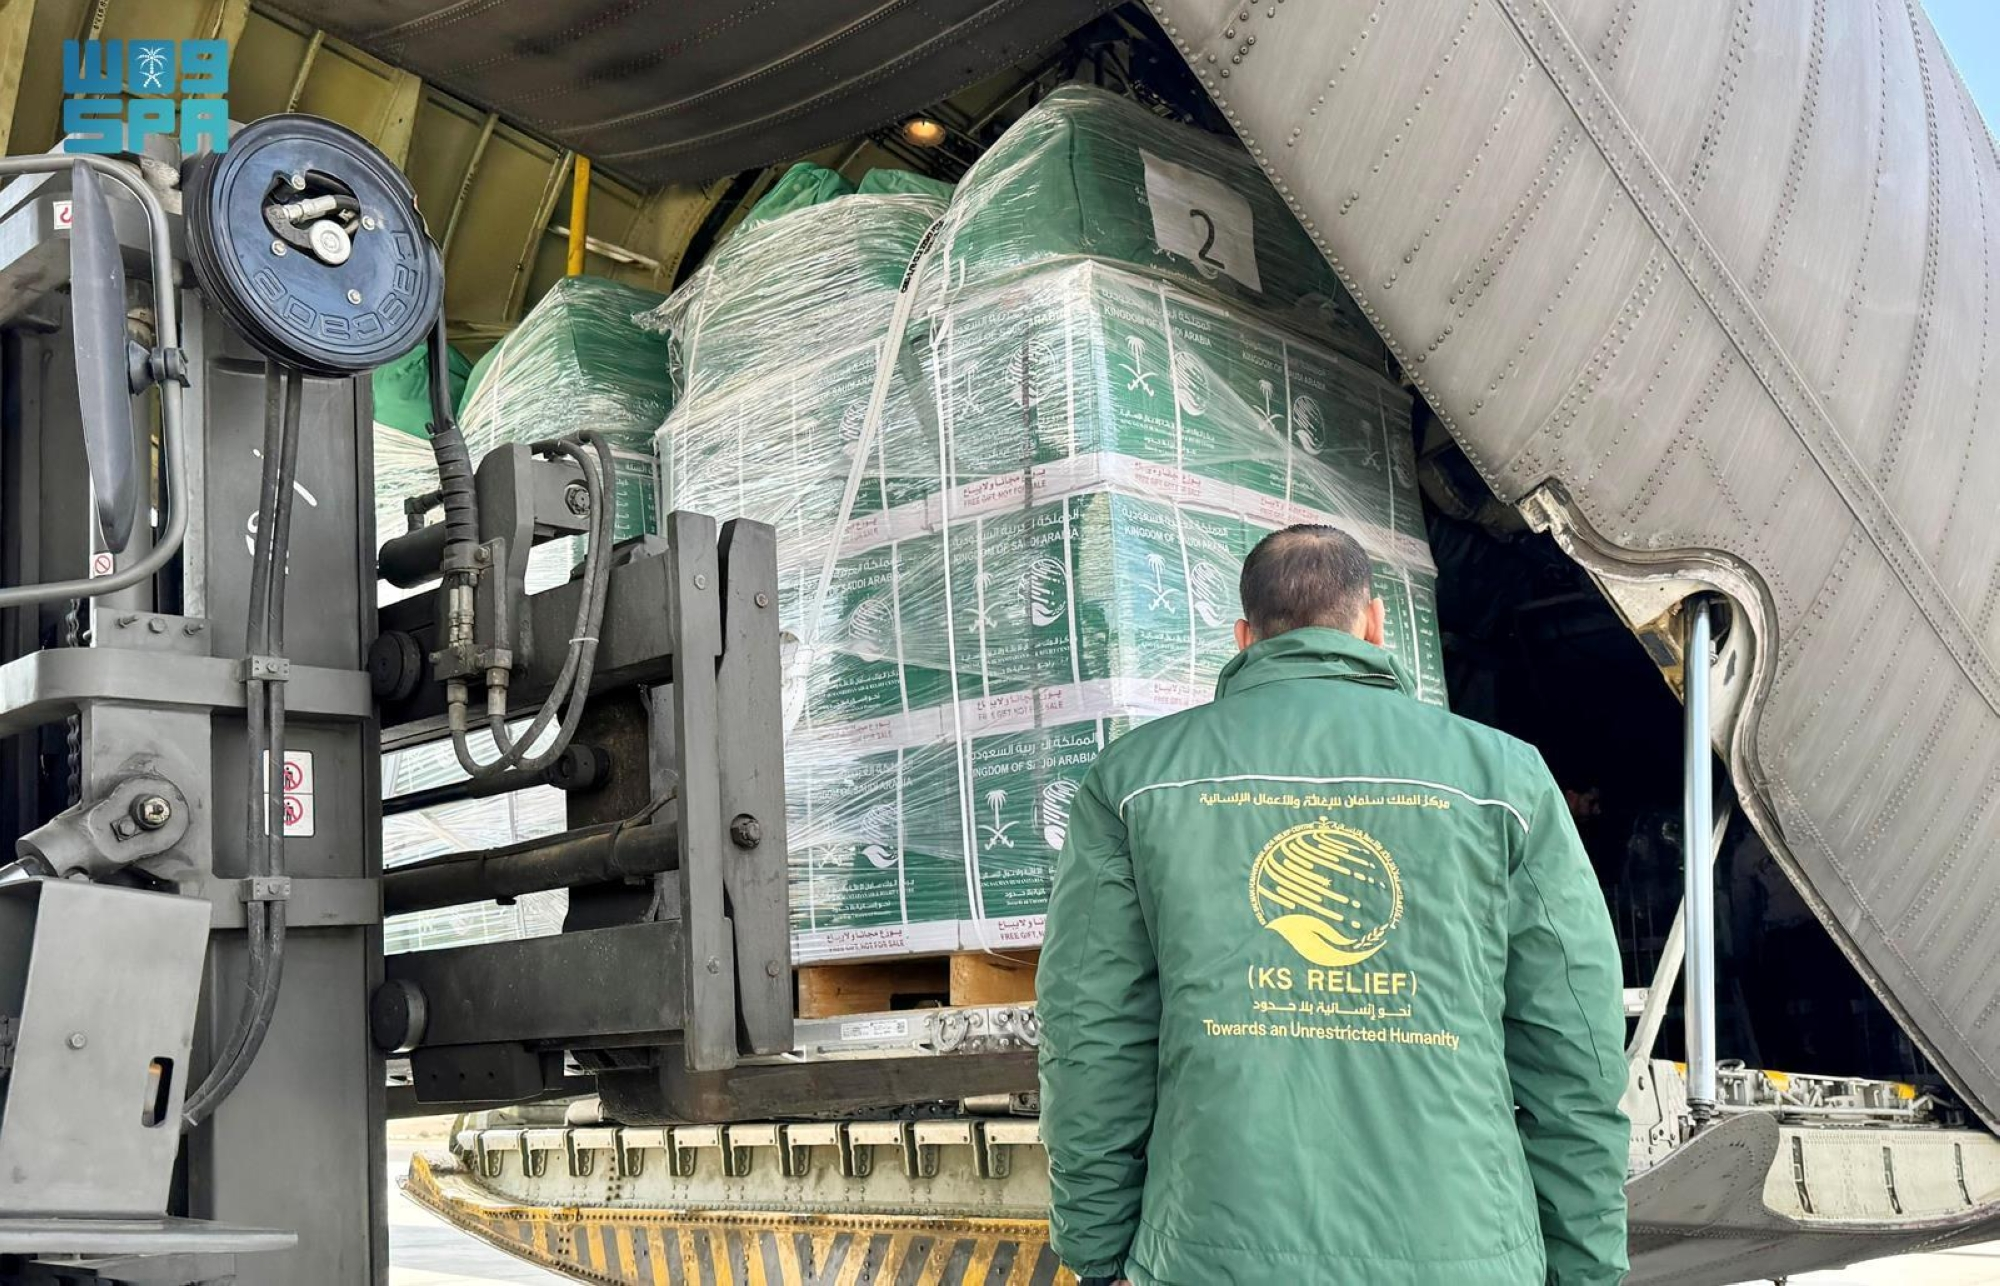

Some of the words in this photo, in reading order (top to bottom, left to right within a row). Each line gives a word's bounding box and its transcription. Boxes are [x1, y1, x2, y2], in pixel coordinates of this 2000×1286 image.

[1189, 209, 1225, 270] 2
[1123, 525, 1162, 541] KINGDOM
[1011, 761, 1023, 773] OF
[1058, 751, 1098, 767] ARABIA
[1344, 793, 1384, 809] سلمان
[1386, 793, 1421, 807] الملك
[1422, 794, 1450, 810] مركز
[1000, 932, 1020, 941] FREE
[1247, 964, 1293, 991] (KS
[1307, 968, 1419, 997] RELIEF)
[1252, 999, 1297, 1013] حدود
[1299, 1000, 1314, 1015] بلا
[1203, 1019, 1267, 1037] Towards
[1270, 1022, 1288, 1037] an
[1290, 1020, 1386, 1043] Unrestricted
[1390, 1026, 1460, 1051] Humanity
